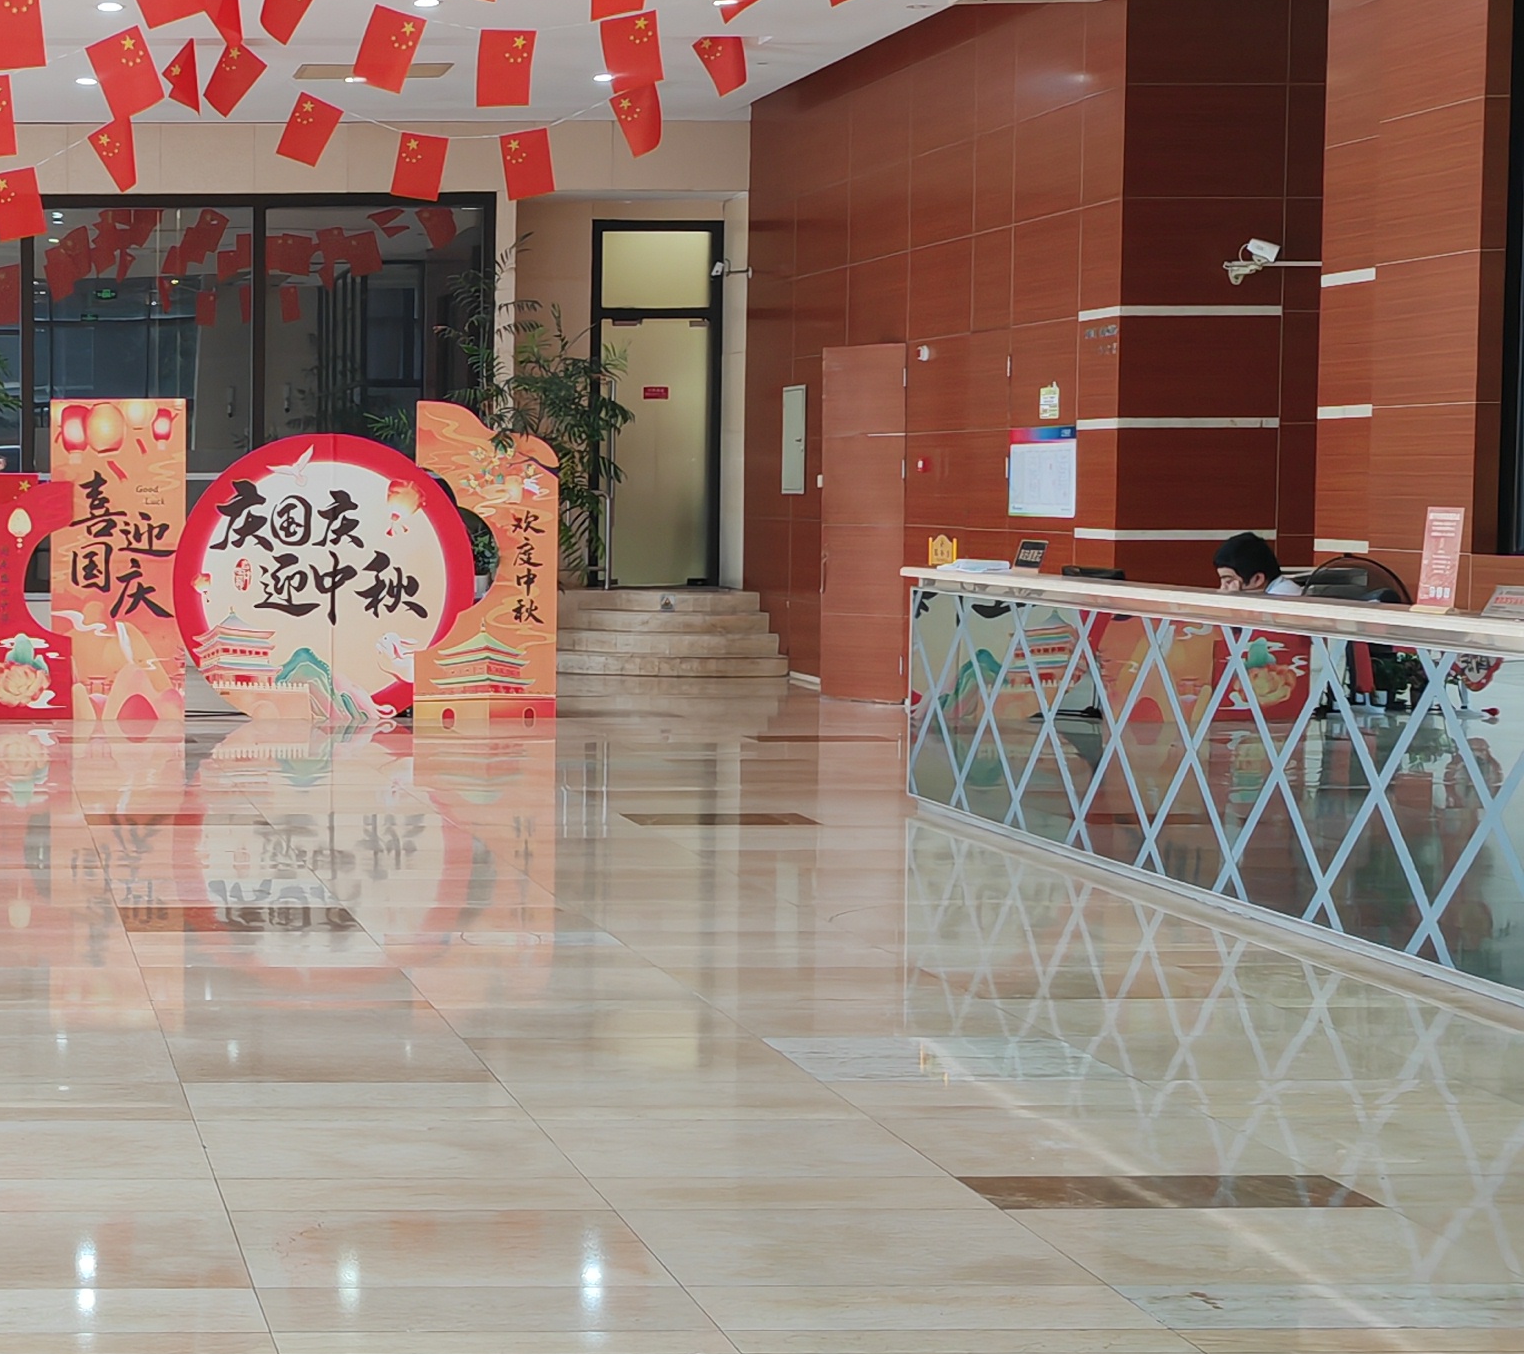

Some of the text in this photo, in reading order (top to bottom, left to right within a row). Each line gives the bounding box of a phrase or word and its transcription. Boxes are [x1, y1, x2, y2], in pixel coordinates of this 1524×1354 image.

[135, 485, 160, 493] Good
[145, 498, 165, 506] Luck
[209, 479, 365, 552] 庆国庆
[254, 550, 429, 625] 迎中秋
[511, 510, 545, 624] 欢度中秋
